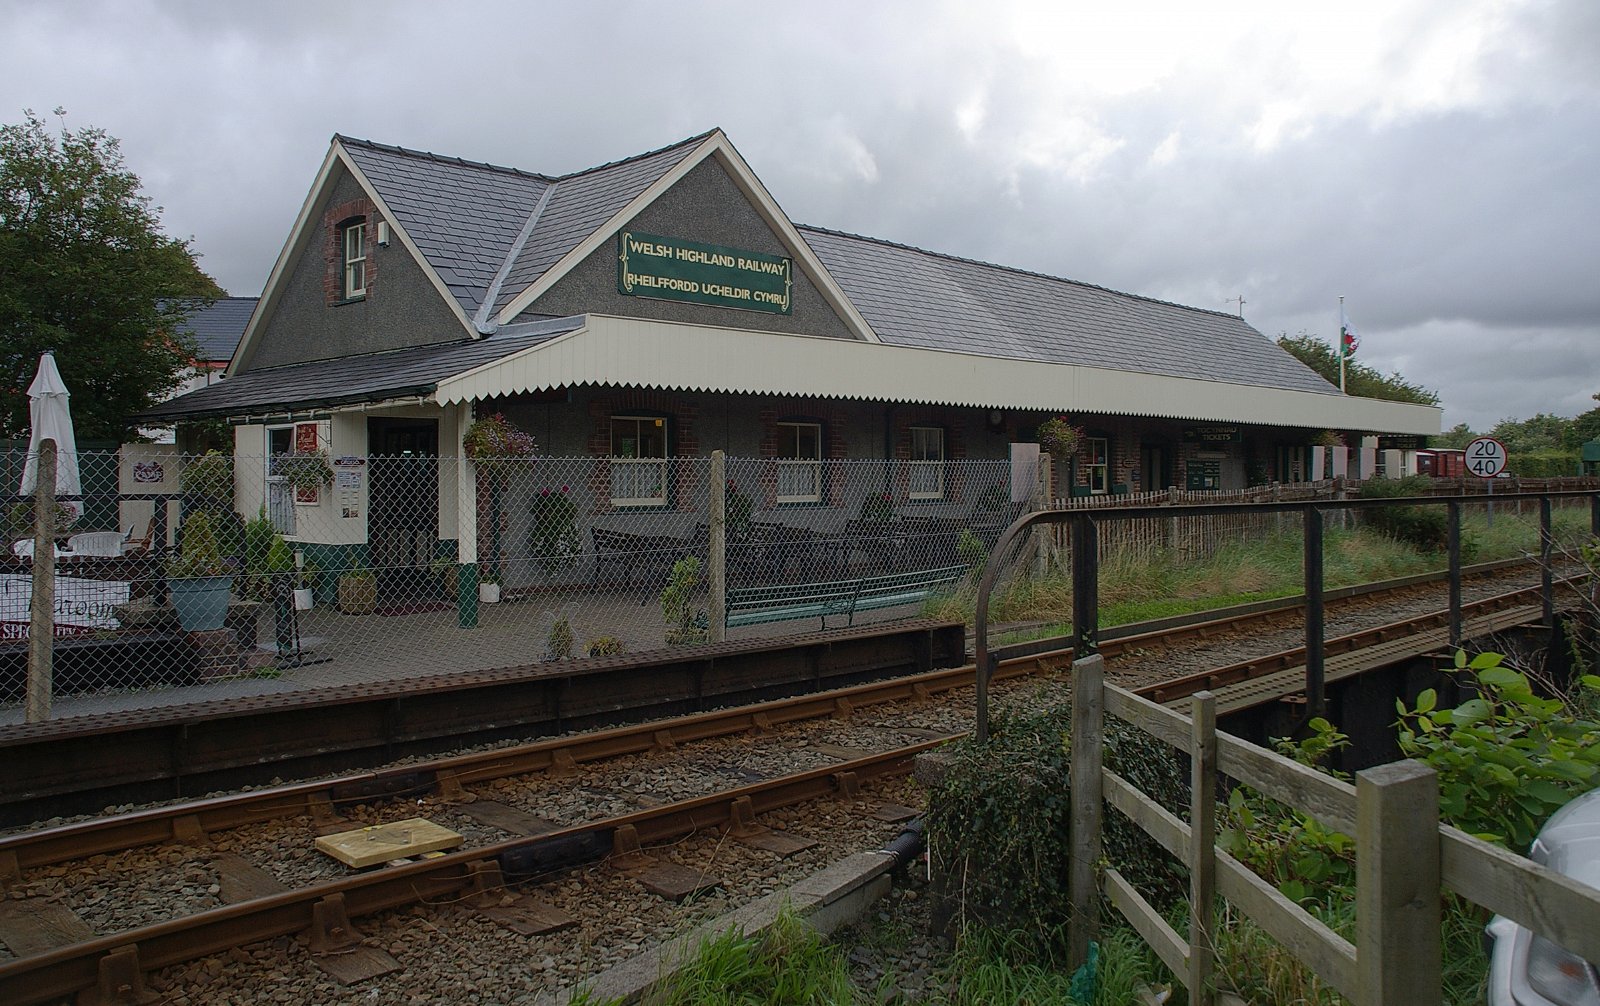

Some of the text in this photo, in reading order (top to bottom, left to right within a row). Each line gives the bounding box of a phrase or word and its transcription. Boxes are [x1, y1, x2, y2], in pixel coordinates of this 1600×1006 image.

[630, 240, 785, 276] WELSH HIGHLAND RAILWAY
[627, 273, 787, 305] RHEILFFORDD UCHELDIR CYMRU
[1203, 433, 1231, 441] TICKETS
[1475, 441, 1496, 456] 20
[1472, 460, 1496, 475] 40
